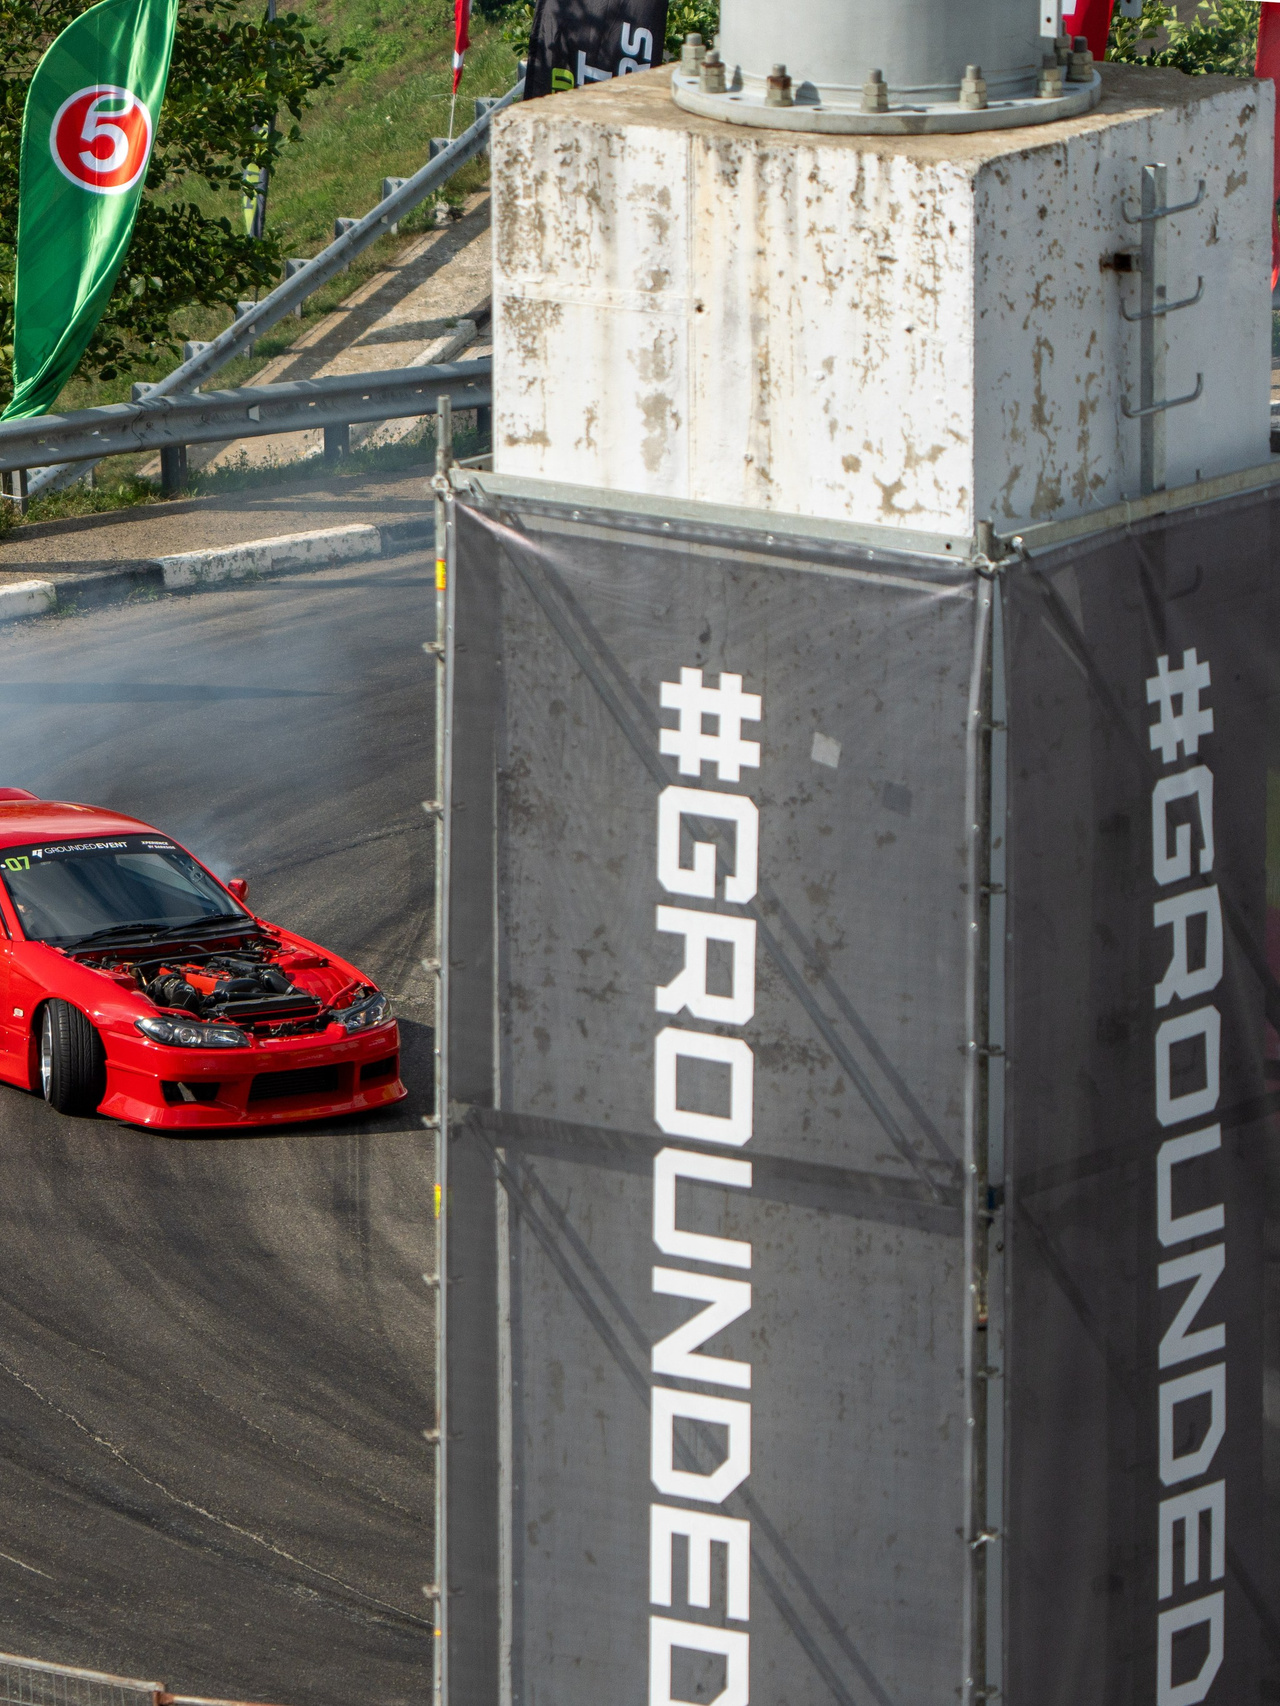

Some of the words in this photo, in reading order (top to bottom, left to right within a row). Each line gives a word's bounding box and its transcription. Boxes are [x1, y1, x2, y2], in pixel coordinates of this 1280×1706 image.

[77, 90, 132, 173] 5
[4, 855, 31, 872] 07
[649, 666, 762, 1706] #GROUNDED
[1147, 647, 1226, 1706] #GROUNDED
